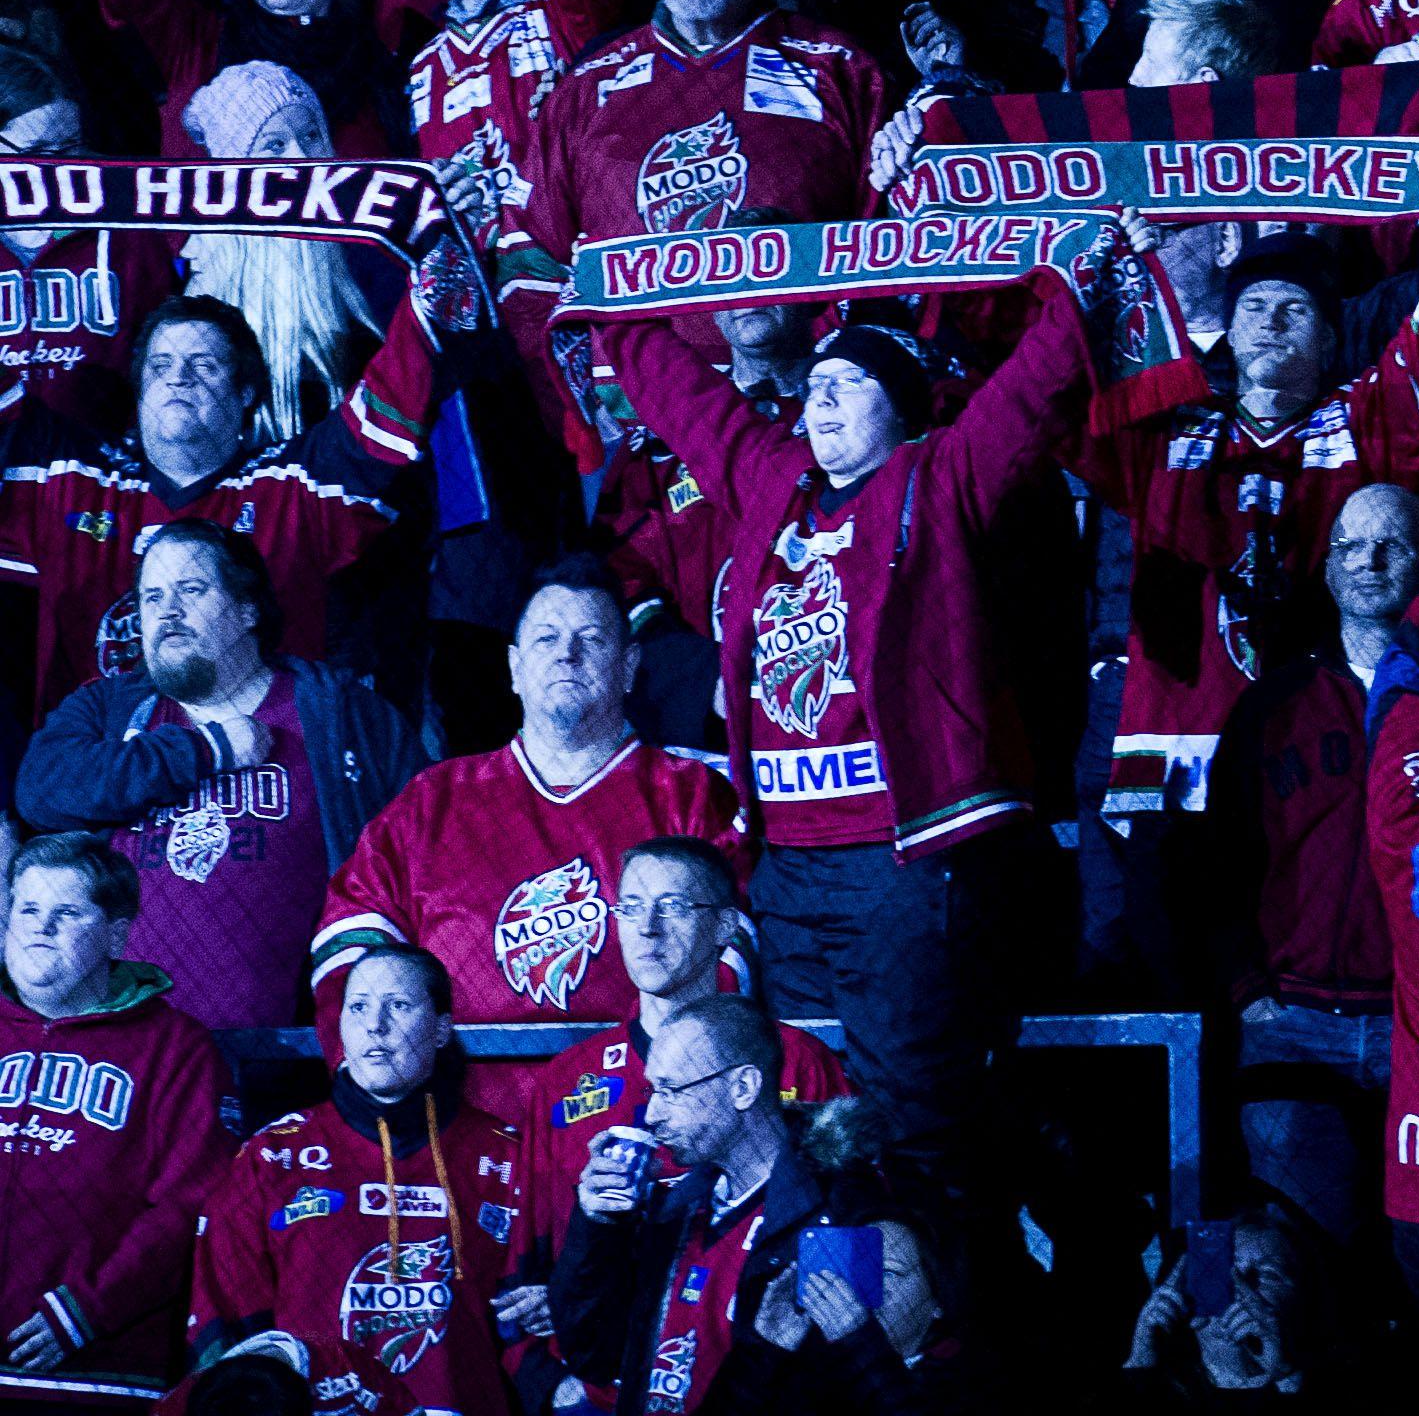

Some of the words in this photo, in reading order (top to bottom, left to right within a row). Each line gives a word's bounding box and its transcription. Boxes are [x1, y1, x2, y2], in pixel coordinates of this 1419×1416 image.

[135, 164, 445, 239] HOCKEY
[645, 155, 742, 202] MODO
[896, 145, 1107, 220] MODO
[603, 226, 790, 298] MODO
[819, 211, 1083, 278] HOCKEY
[756, 607, 843, 661] MODO
[502, 898, 602, 945] MODO
[347, 1283, 450, 1311] MODO
